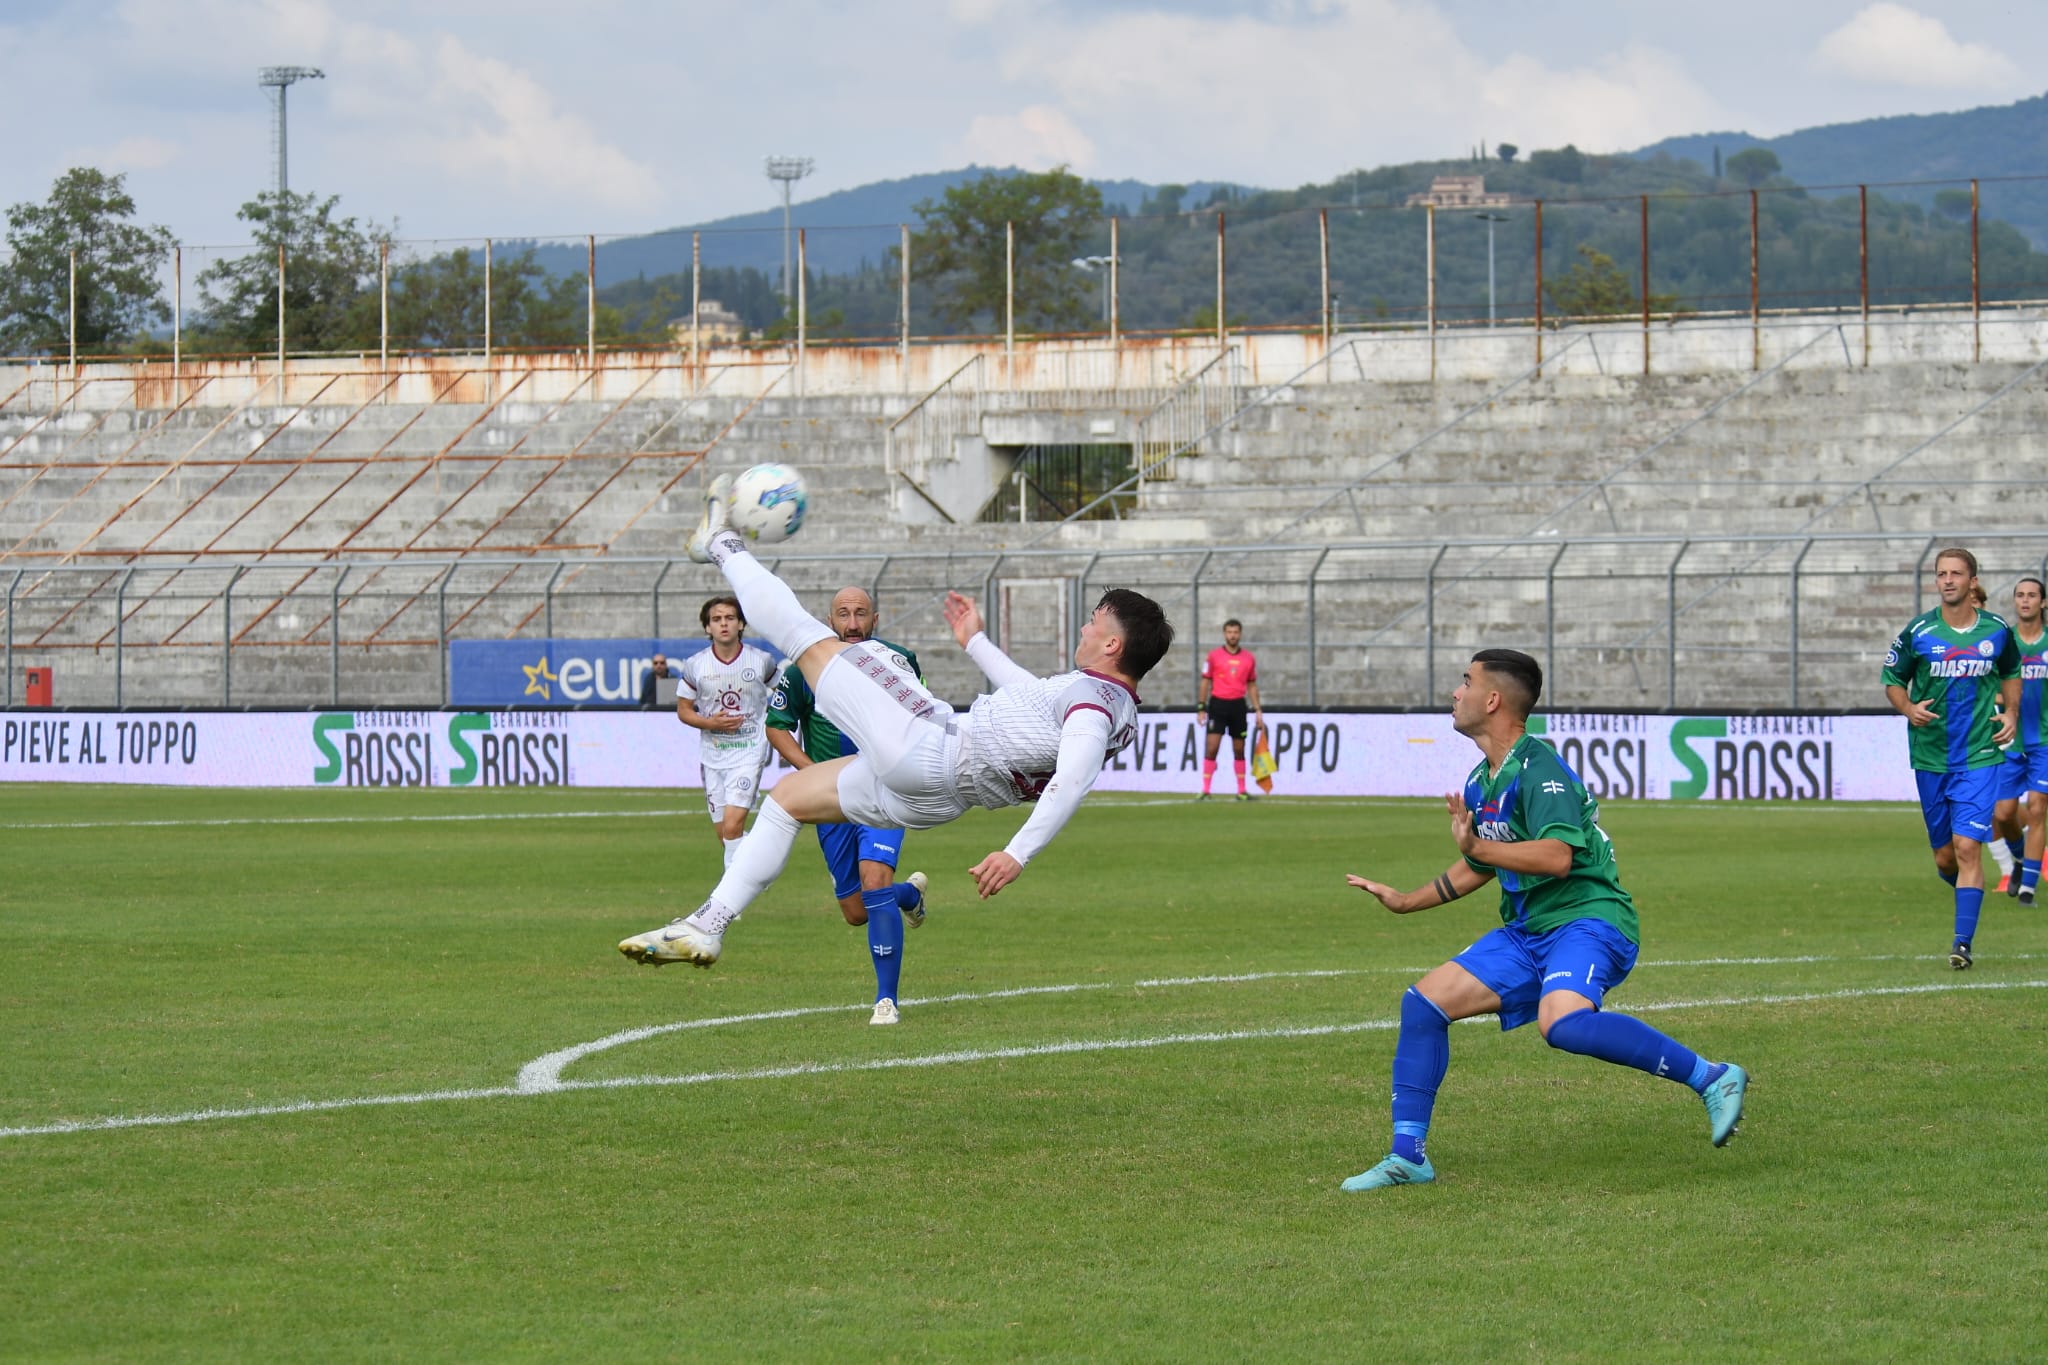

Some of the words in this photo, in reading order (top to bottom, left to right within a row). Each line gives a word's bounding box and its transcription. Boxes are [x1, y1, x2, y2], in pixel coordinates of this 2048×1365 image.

[4, 720, 70, 763] PIEVE
[78, 721, 107, 764] AL
[116, 721, 197, 764] TOPPO
[356, 711, 431, 727] SERRAMENTI
[493, 711, 568, 728] SERRAMENTI
[1550, 714, 1646, 732] SERRAMENTI
[1730, 716, 1834, 735] SERRAMENTI
[345, 732, 431, 786] ROSSI
[482, 733, 568, 786] ROSSI
[1251, 723, 1339, 773] OPPO
[1541, 737, 1646, 798] OSSI
[1715, 740, 1833, 799] ROSSI
